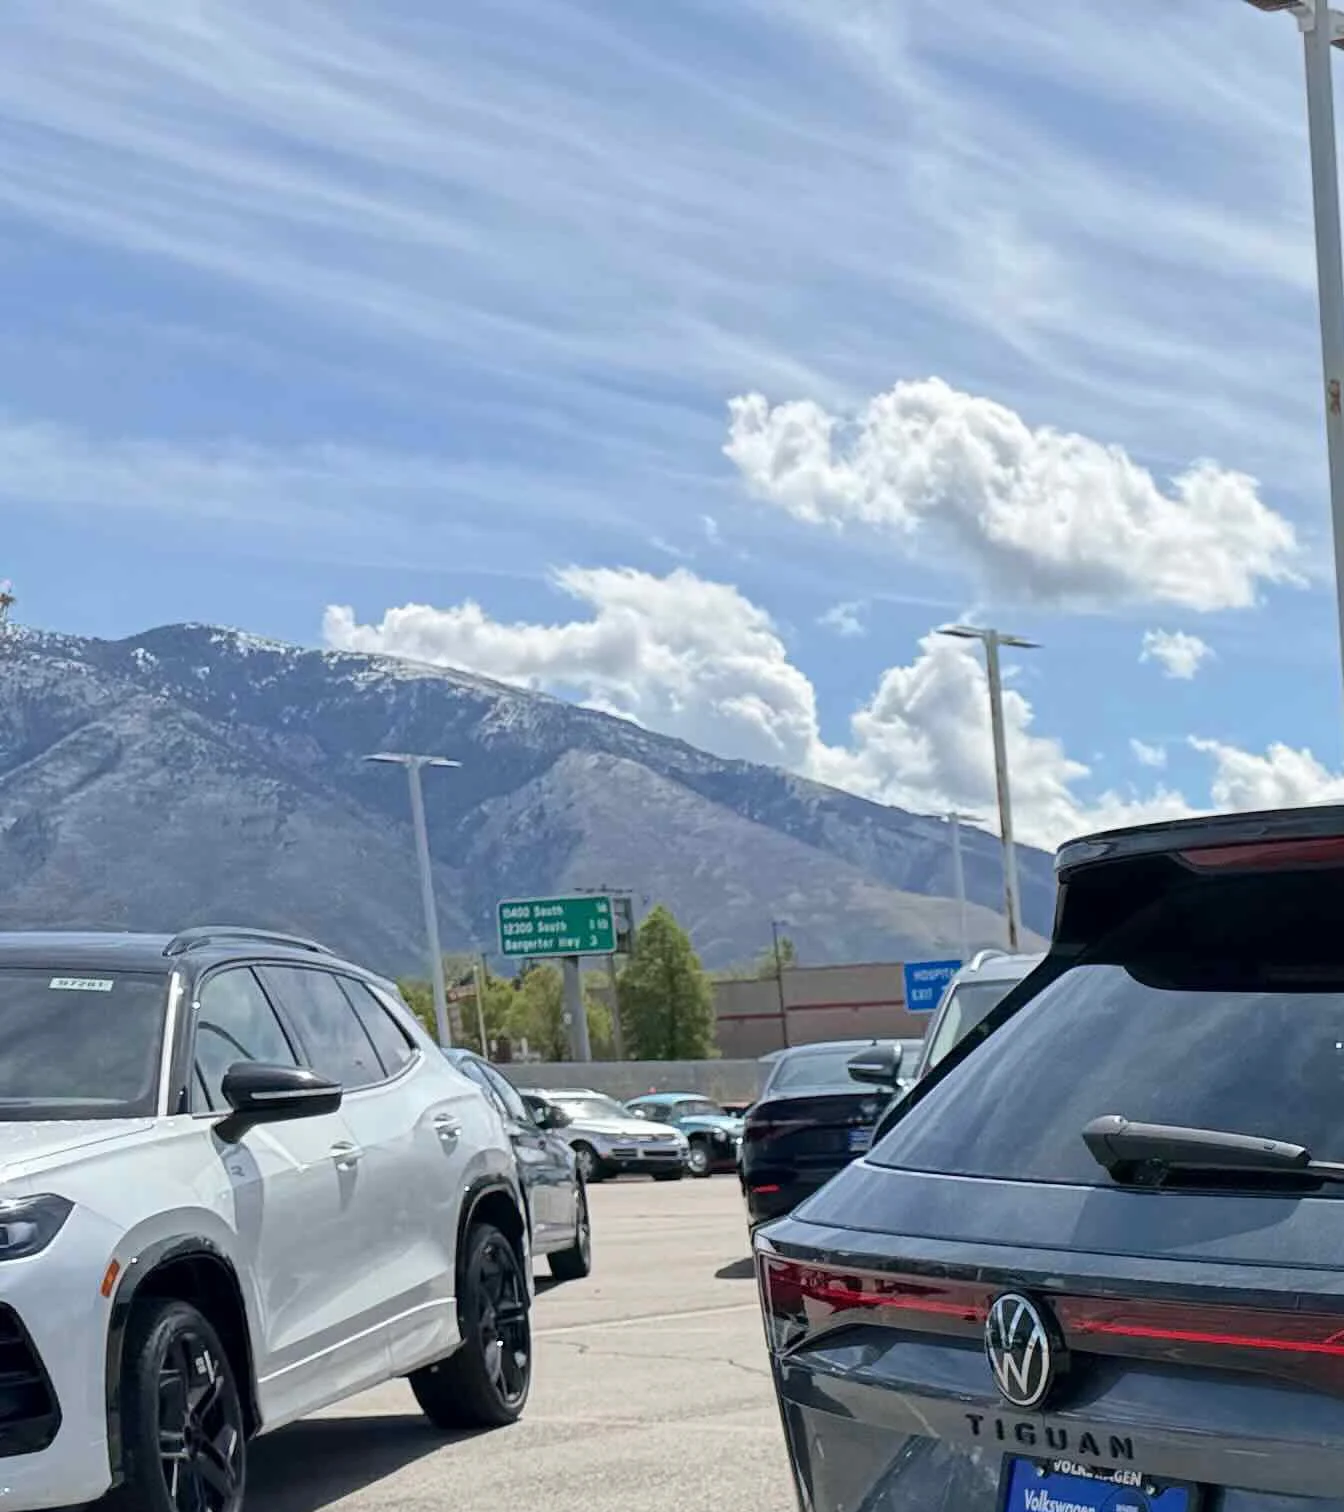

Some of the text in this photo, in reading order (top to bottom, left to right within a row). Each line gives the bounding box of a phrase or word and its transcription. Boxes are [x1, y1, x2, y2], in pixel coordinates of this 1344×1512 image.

[533, 905, 564, 918] South
[537, 920, 567, 933] South
[964, 1413, 1136, 1460] TIGUAN
